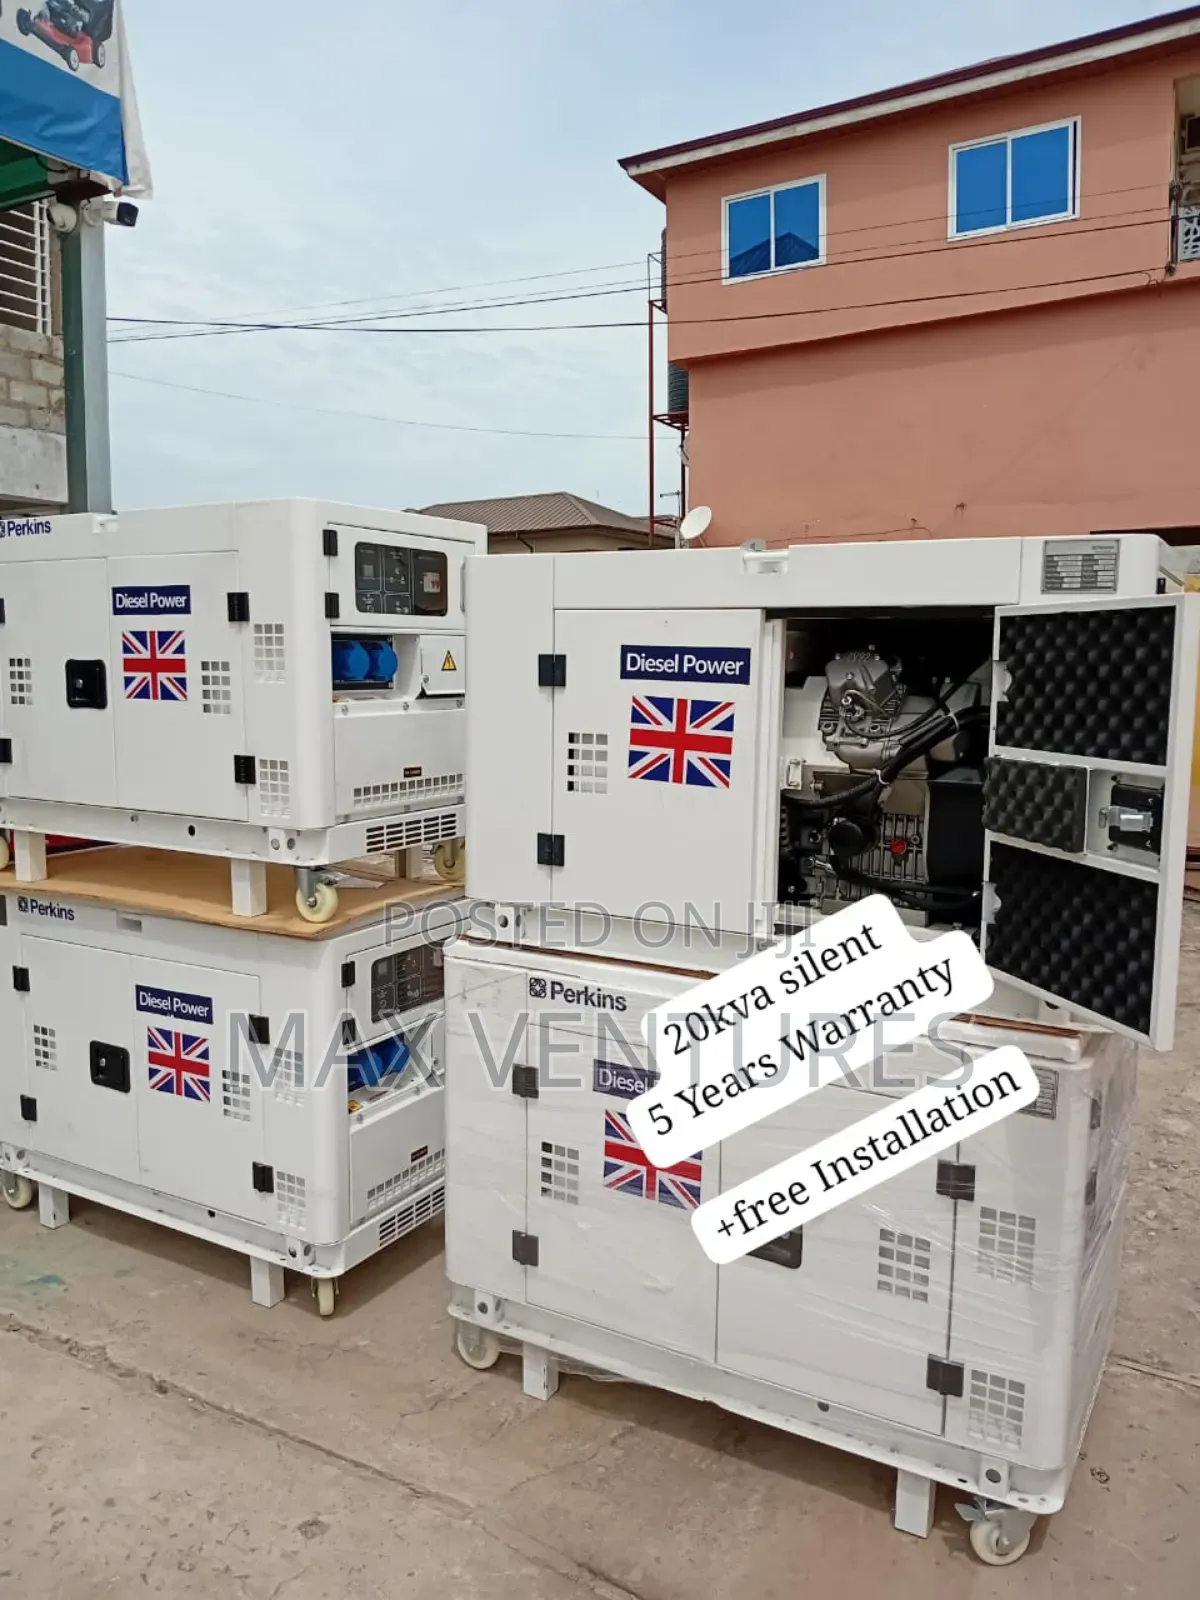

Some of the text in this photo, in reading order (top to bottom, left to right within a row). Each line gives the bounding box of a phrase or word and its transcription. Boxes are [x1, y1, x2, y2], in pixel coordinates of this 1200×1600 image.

[7, 519, 52, 537] Perkins
[115, 592, 188, 609] Diesel Power
[626, 652, 744, 676] Diesel Power
[30, 899, 75, 921] Perkins
[139, 991, 210, 1018] Diesel Power
[550, 979, 628, 1012] Perkins
[599, 1067, 649, 1093] Diesel
